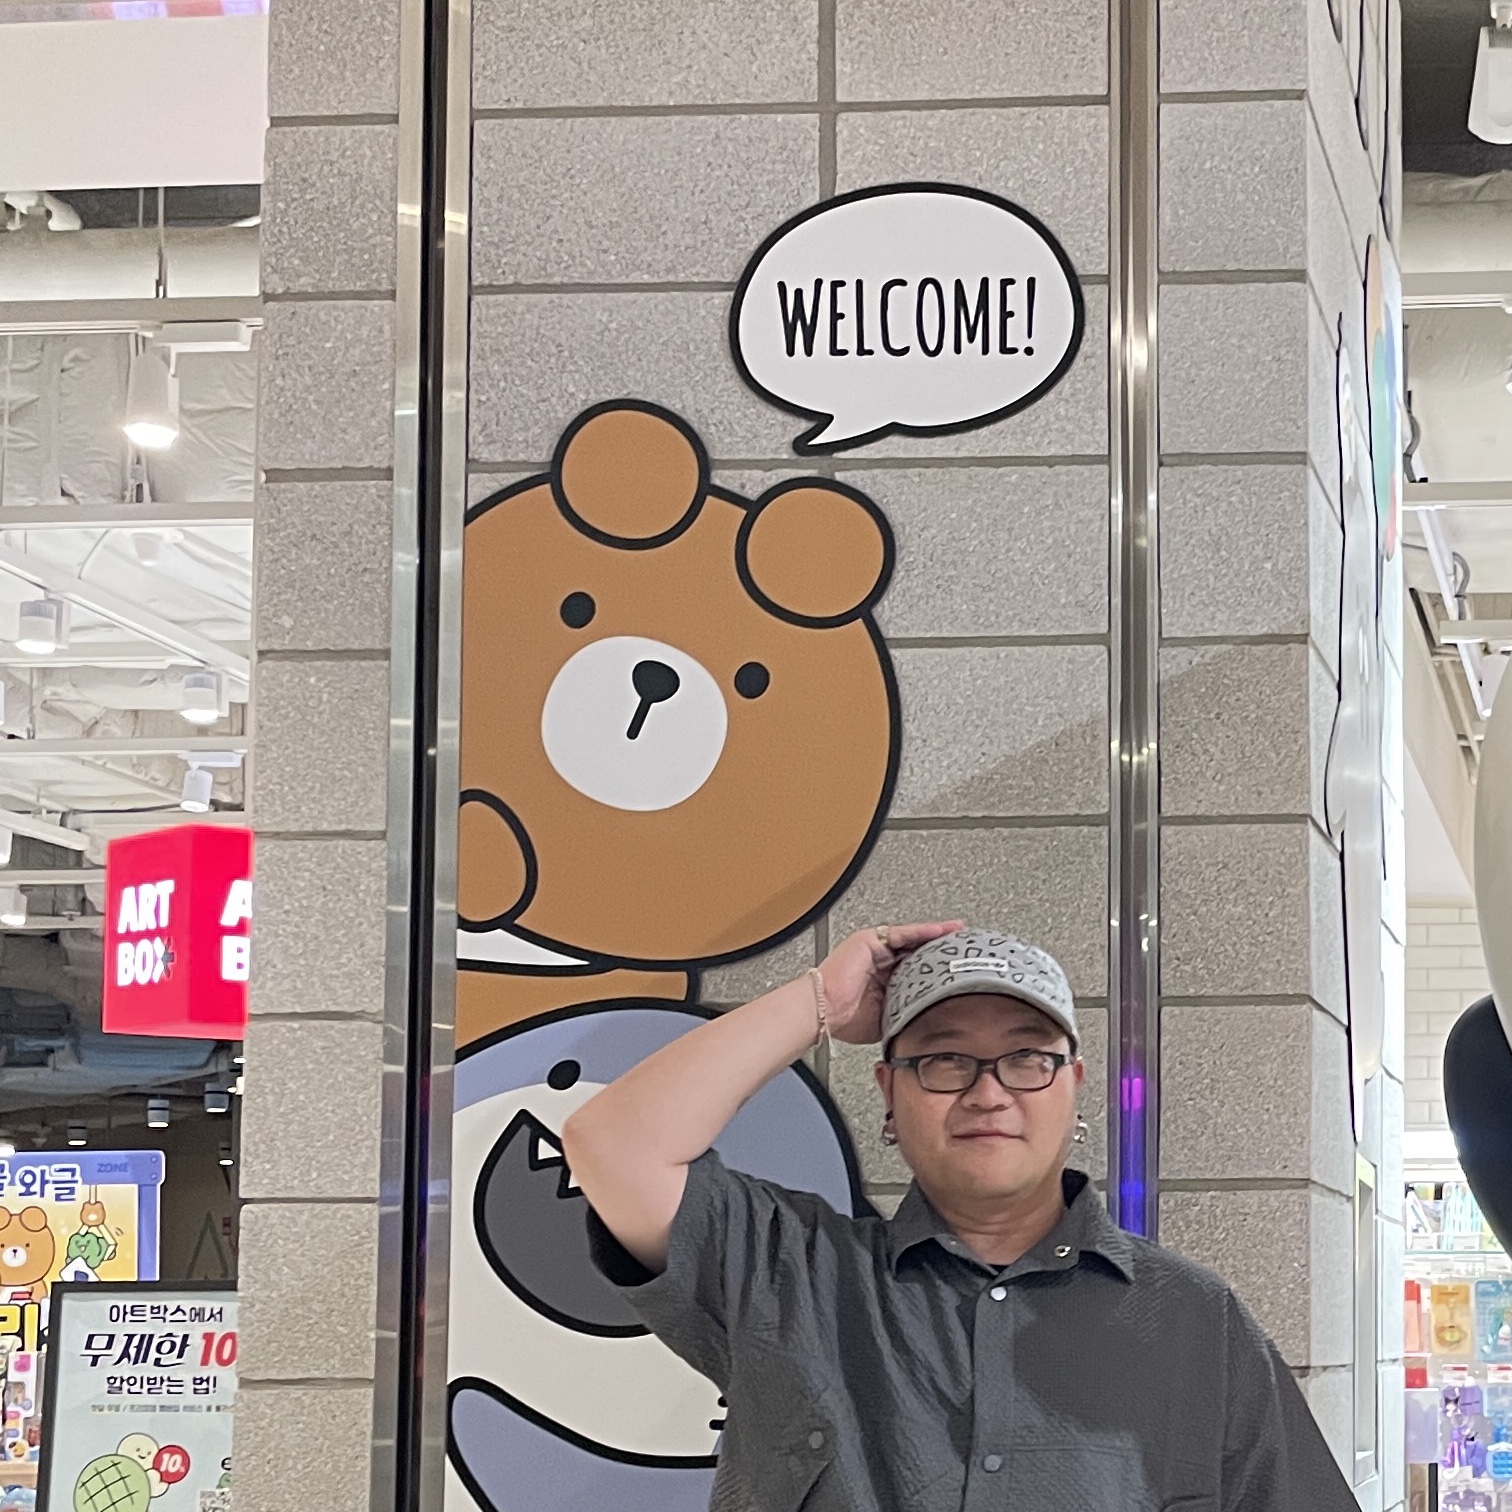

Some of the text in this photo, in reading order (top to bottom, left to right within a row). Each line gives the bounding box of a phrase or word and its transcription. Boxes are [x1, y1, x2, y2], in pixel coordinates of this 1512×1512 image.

[777, 276, 1036, 358] WELCOME!
[117, 880, 175, 934] ART
[117, 936, 175, 987] BOX
[18, 1167, 79, 1202] 와글
[109, 1304, 223, 1323] 아트박스에서
[80, 1331, 190, 1368] 무제한
[106, 1375, 218, 1395] 할인받는 법!
